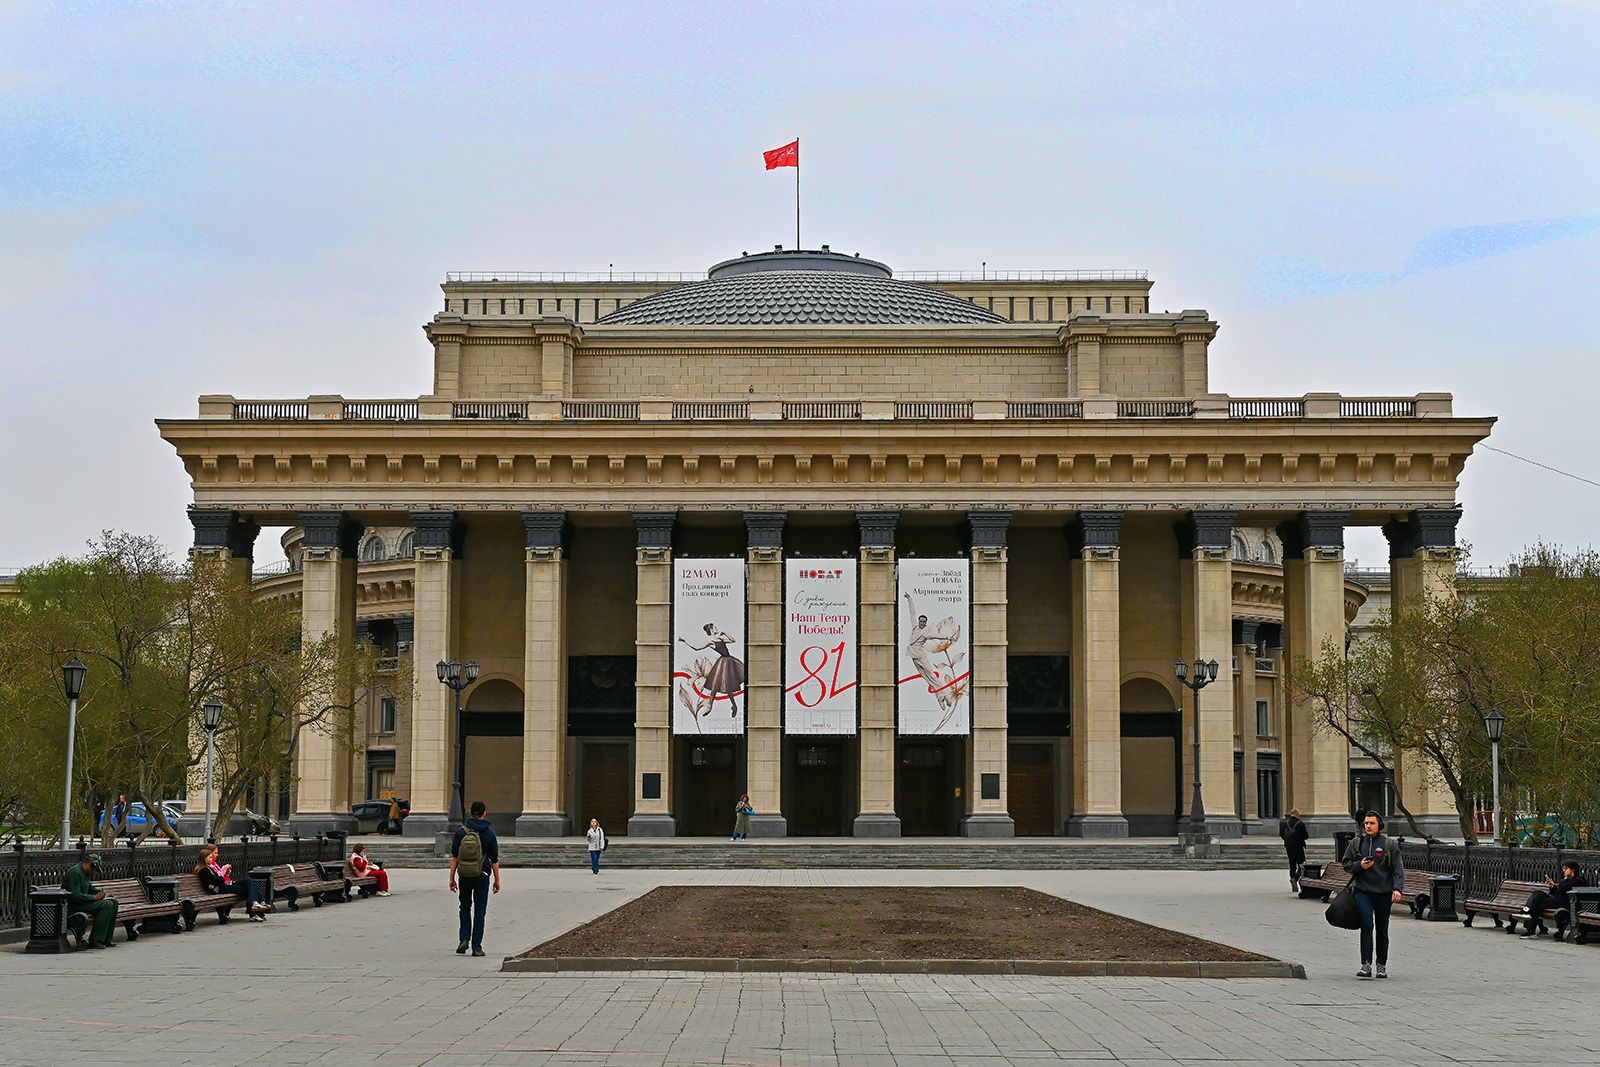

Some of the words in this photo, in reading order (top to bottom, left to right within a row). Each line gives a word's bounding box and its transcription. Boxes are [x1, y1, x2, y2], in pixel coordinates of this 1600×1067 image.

[682, 569, 692, 578] 12
[693, 569, 717, 578] МАЯ
[799, 569, 843, 579] НОВАТ
[913, 588, 962, 596] Мариинского
[791, 613, 816, 622] Наш
[818, 613, 851, 625] Театр
[798, 624, 844, 635] Победы!
[789, 641, 851, 708] 81
